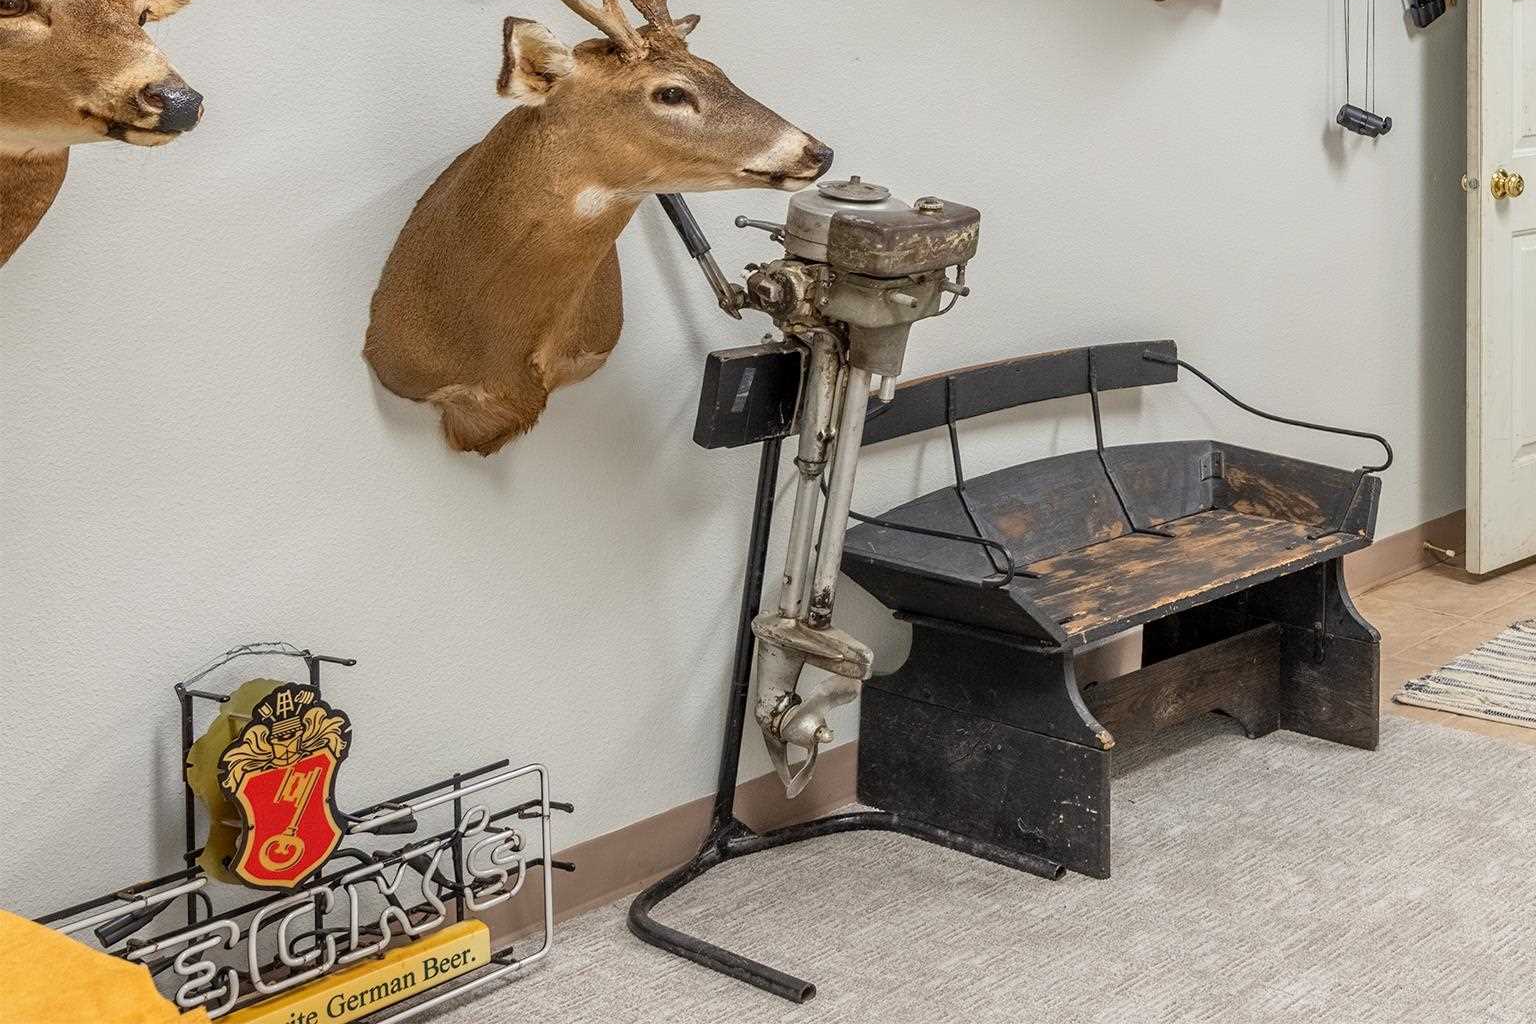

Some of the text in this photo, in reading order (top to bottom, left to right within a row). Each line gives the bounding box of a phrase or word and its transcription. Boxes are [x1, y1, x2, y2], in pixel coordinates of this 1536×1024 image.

[140, 804, 528, 1020] ECK'S
[326, 948, 476, 1018] German Beer.
